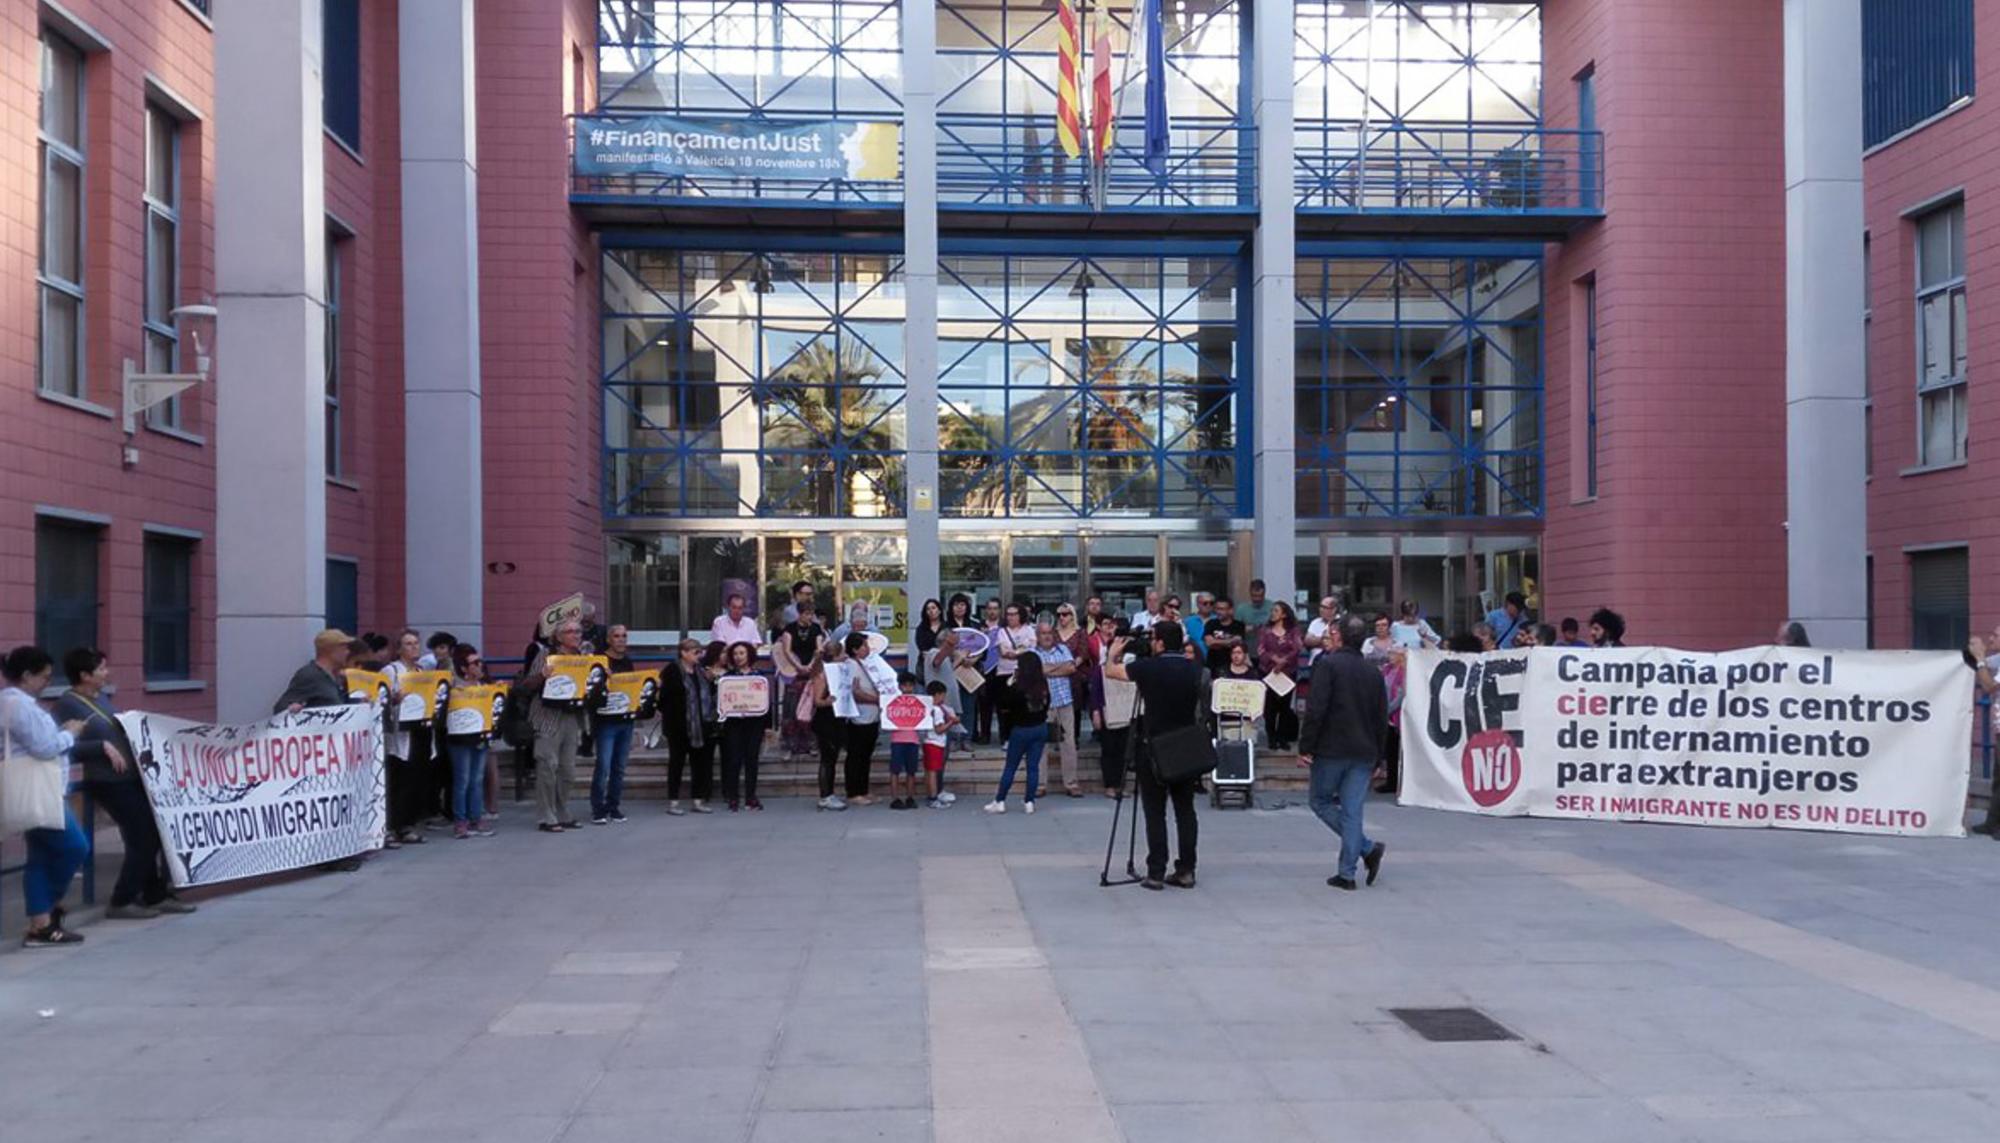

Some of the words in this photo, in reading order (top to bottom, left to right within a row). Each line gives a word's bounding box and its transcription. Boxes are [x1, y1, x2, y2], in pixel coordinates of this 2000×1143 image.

[590, 129, 822, 153] #FinançamentJust
[596, 152, 672, 165] manifestació
[675, 156, 682, 165] a
[755, 157, 816, 169] novembre
[1558, 655, 1718, 689] Campaña
[1727, 661, 1787, 690] por
[1798, 656, 1832, 685] el
[1427, 656, 1528, 749] CIE
[1557, 688, 1658, 716] cierre
[1667, 689, 1707, 718] de
[1718, 689, 1769, 718] los
[1779, 694, 1931, 722] centros
[1557, 720, 1599, 749] de
[1608, 721, 1870, 758] internamiento
[171, 742, 197, 788] LA
[243, 733, 341, 784] EUROPEA
[1471, 743, 1511, 792] NO
[182, 806, 260, 850] GENOCIDI
[261, 793, 352, 840] MIGRATORI
[1556, 795, 1594, 812] SER
[1738, 803, 1769, 820] NO
[1774, 804, 1801, 821] ES
[1807, 805, 1839, 823] UN
[1845, 807, 1927, 829] DELITO
